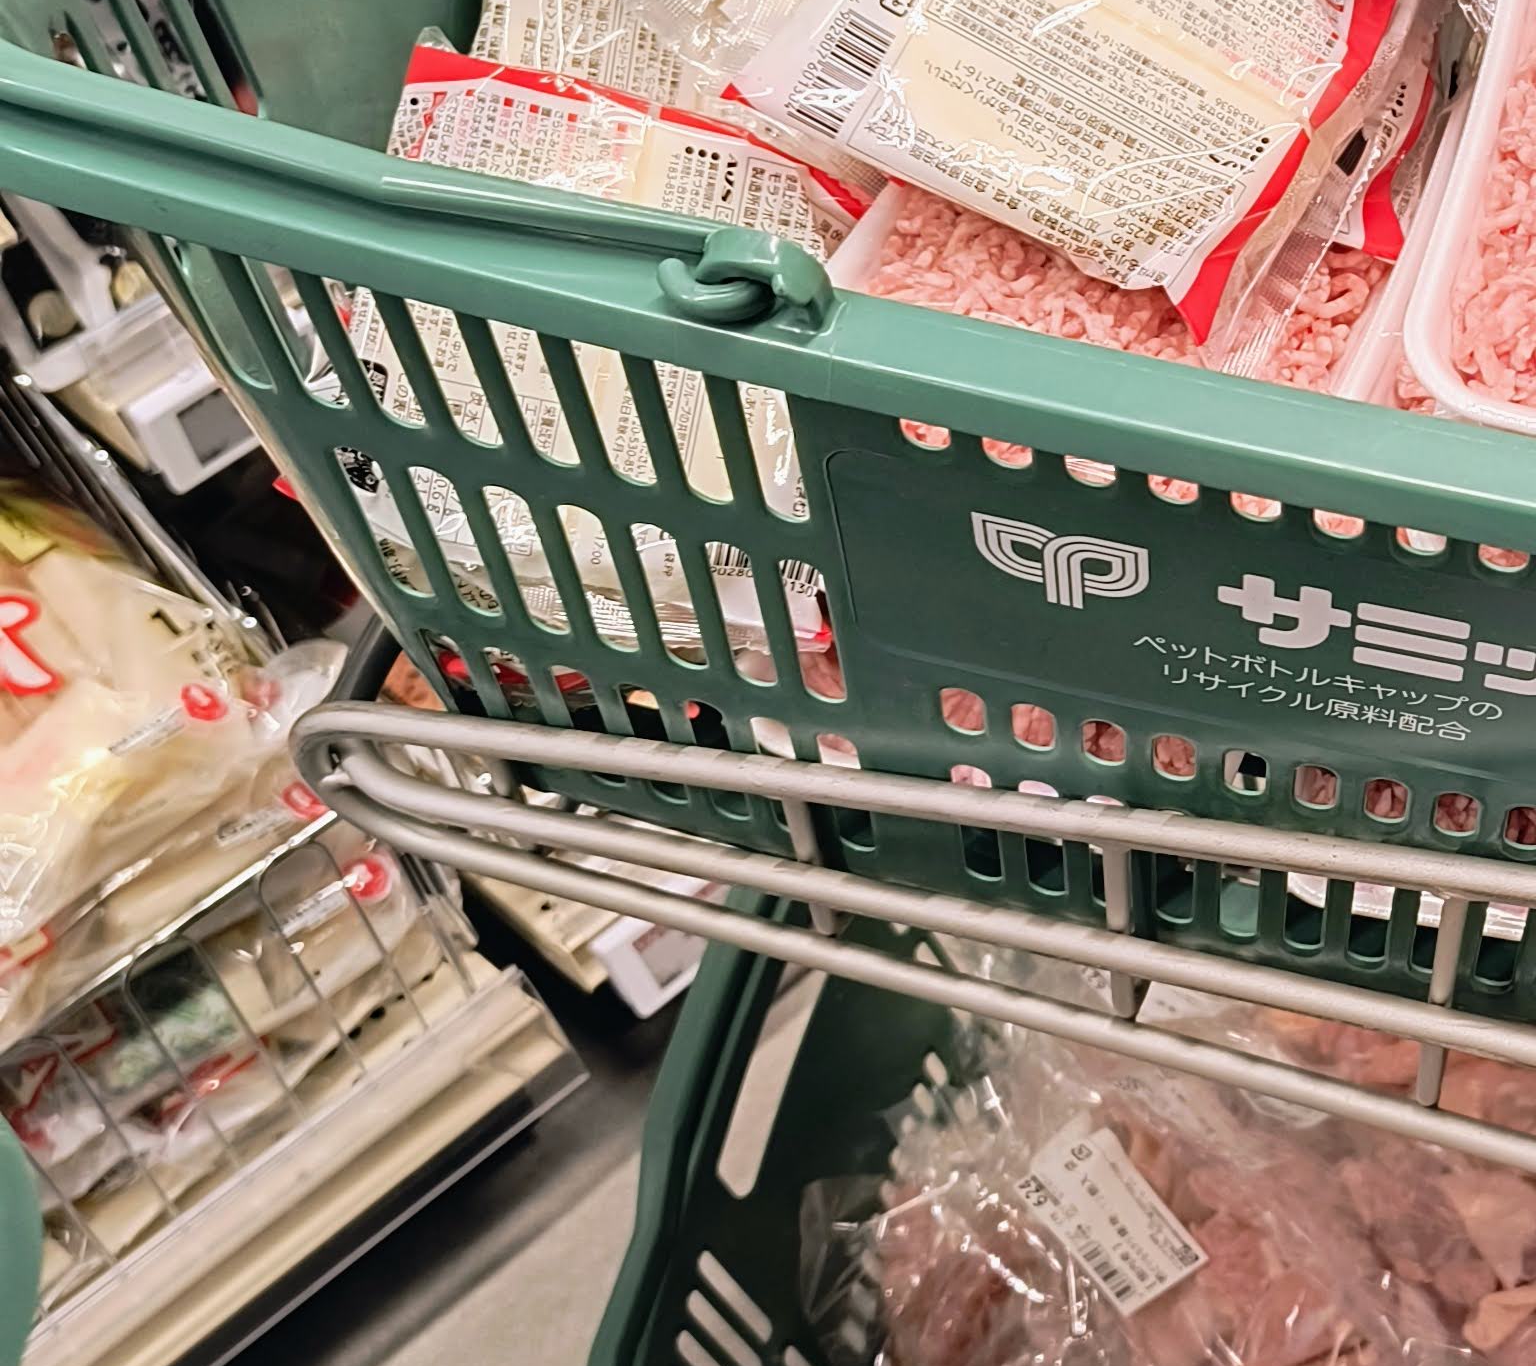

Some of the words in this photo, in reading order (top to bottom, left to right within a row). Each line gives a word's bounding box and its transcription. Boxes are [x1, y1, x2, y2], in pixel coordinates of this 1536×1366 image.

[1133, 632, 1504, 722] ペットボトルキャップの
[1161, 662, 1471, 743] リサイクル原料配合
